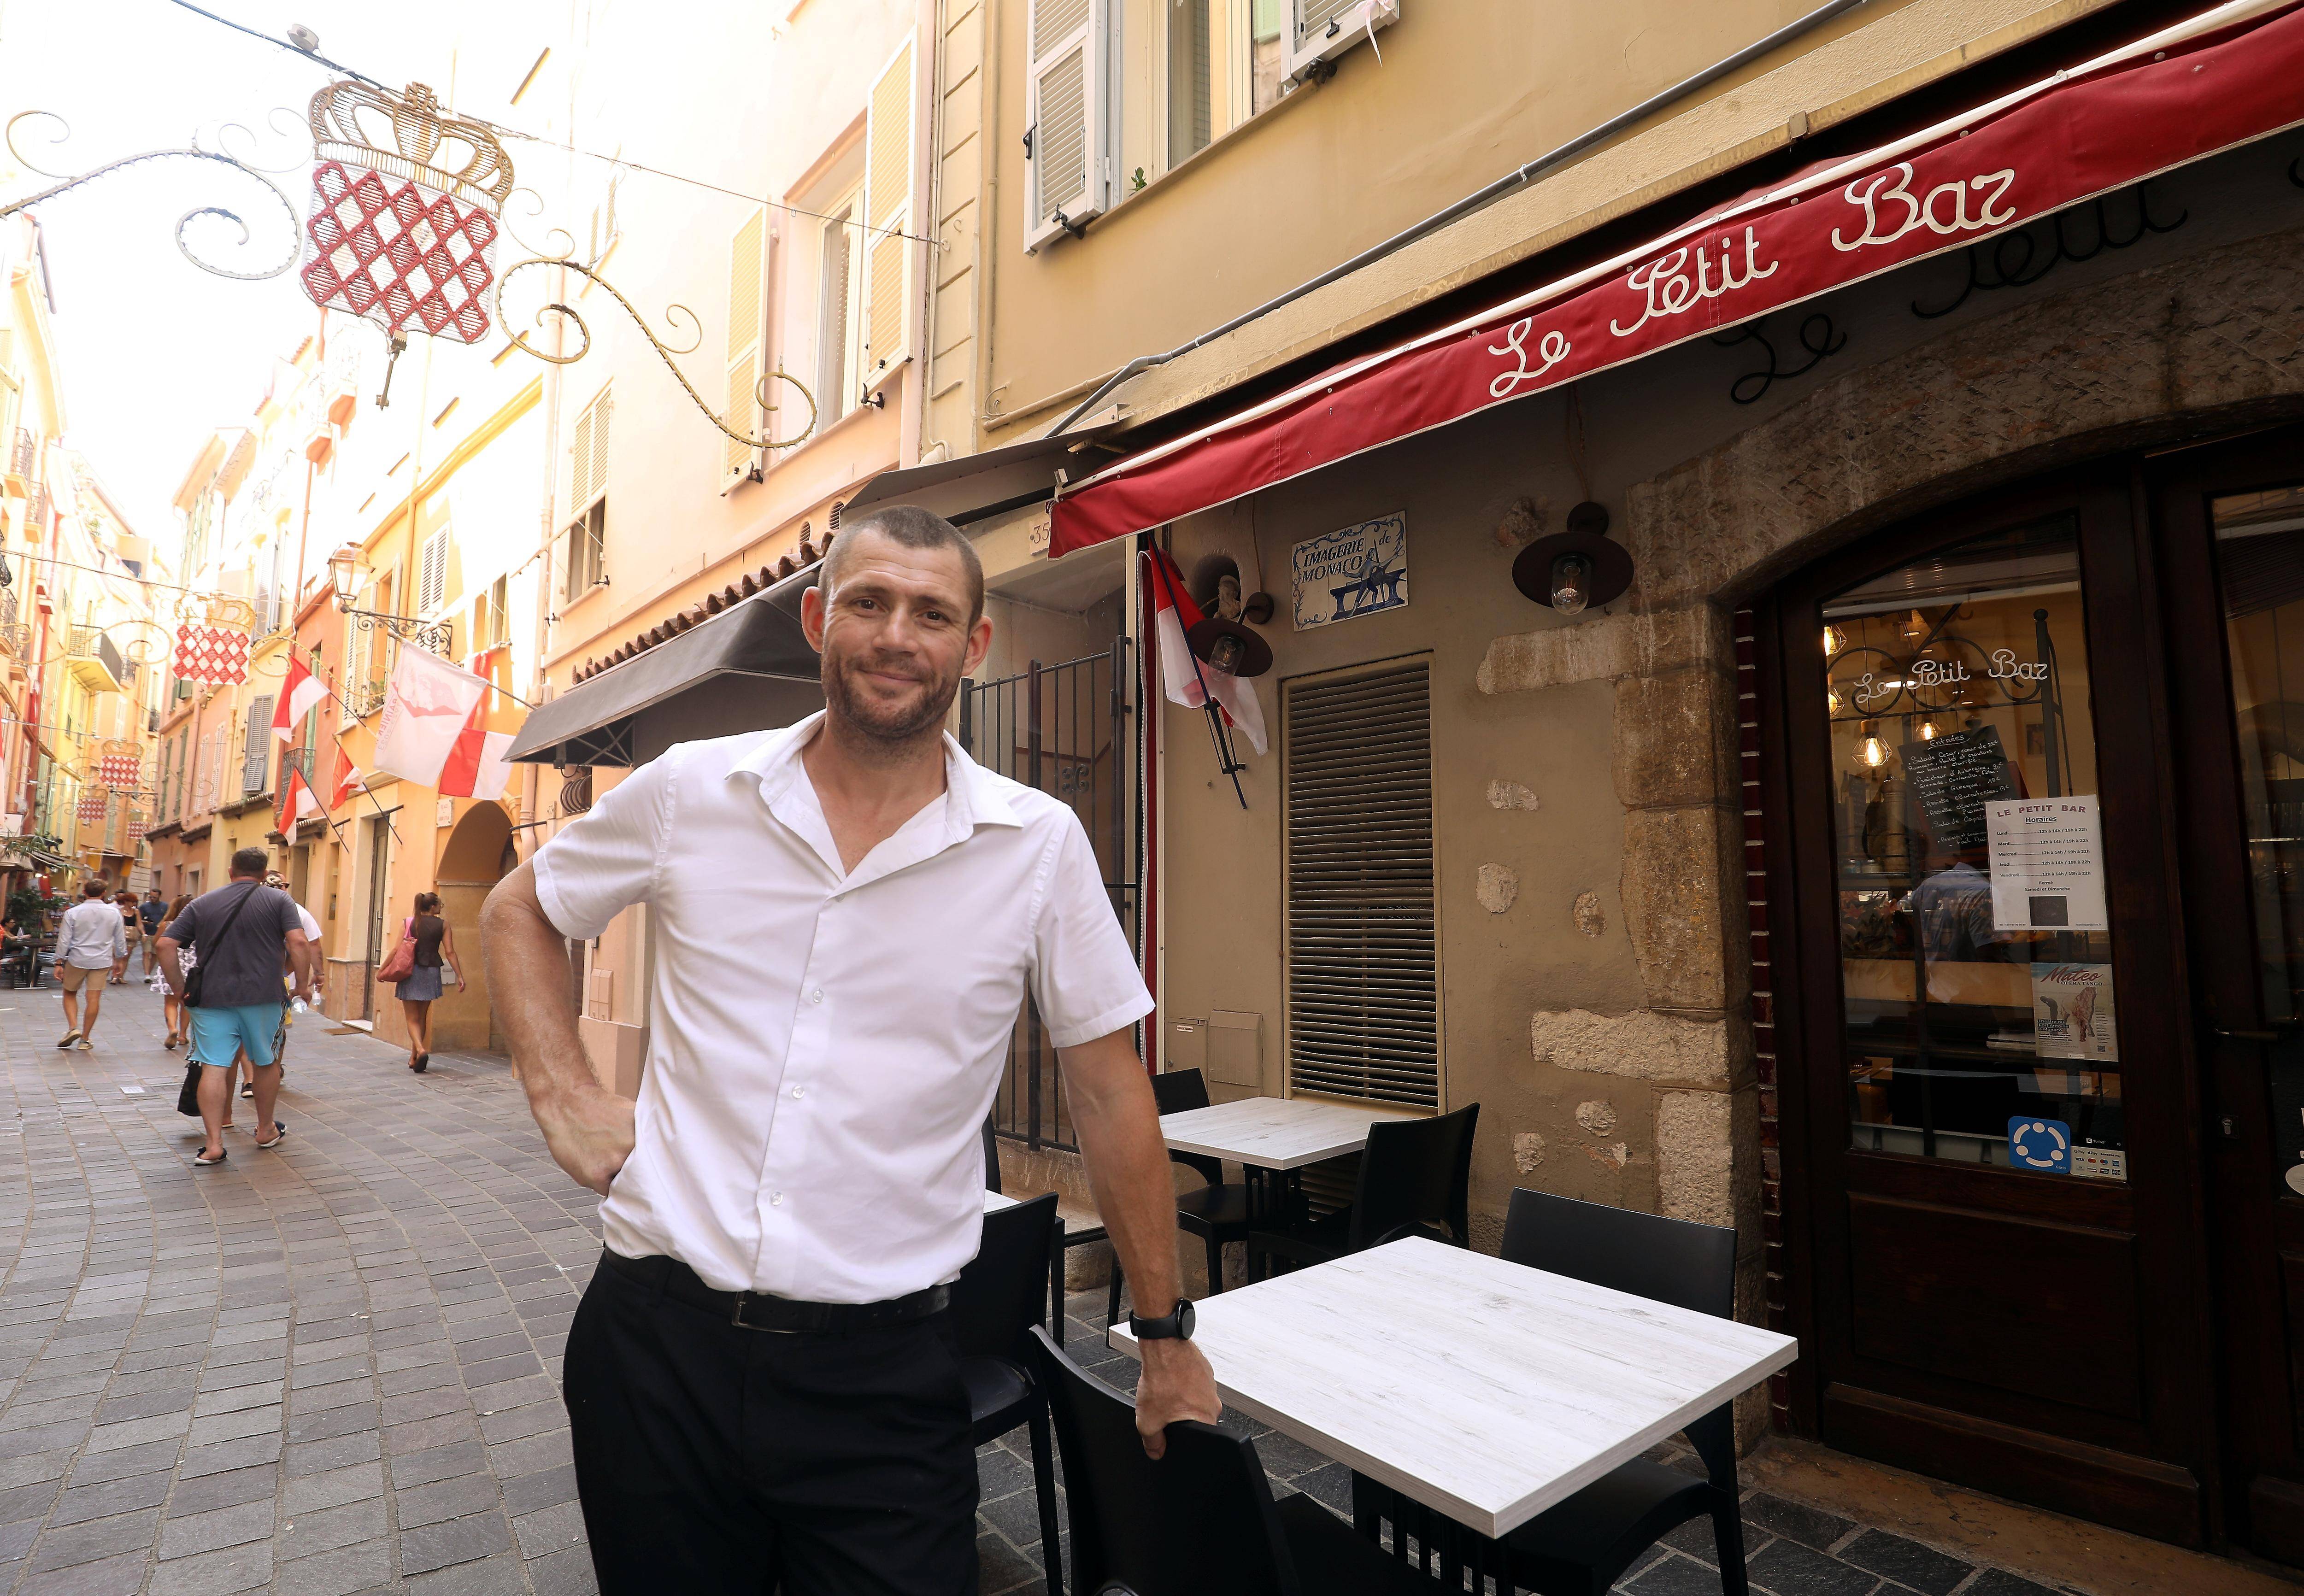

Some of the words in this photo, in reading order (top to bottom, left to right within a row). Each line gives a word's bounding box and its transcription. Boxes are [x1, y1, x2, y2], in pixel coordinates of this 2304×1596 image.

[1488, 317, 1571, 397] Le
[1610, 225, 1779, 337] Petit
[1831, 161, 2016, 252] Bar
[1034, 521, 1050, 544] 35
[1303, 538, 1365, 568] IMAGERIE
[1379, 529, 1391, 545] de
[1301, 555, 1363, 583] MONACO
[1853, 673, 1890, 704] Le
[1907, 660, 1970, 690] Petit
[1987, 648, 2048, 680] Bar
[1910, 755, 1936, 764] Salade
[1939, 756, 1957, 764] Poulet
[1921, 788, 1945, 797] Salade
[1926, 798, 1950, 808] Assiette
[1929, 808, 1953, 816] Assiette
[1997, 809, 2011, 817] LE
[2018, 804, 2052, 813] PETIT
[2061, 804, 2086, 813] BAR
[1933, 819, 1960, 827] Salade
[2040, 966, 2103, 984] Mateo
